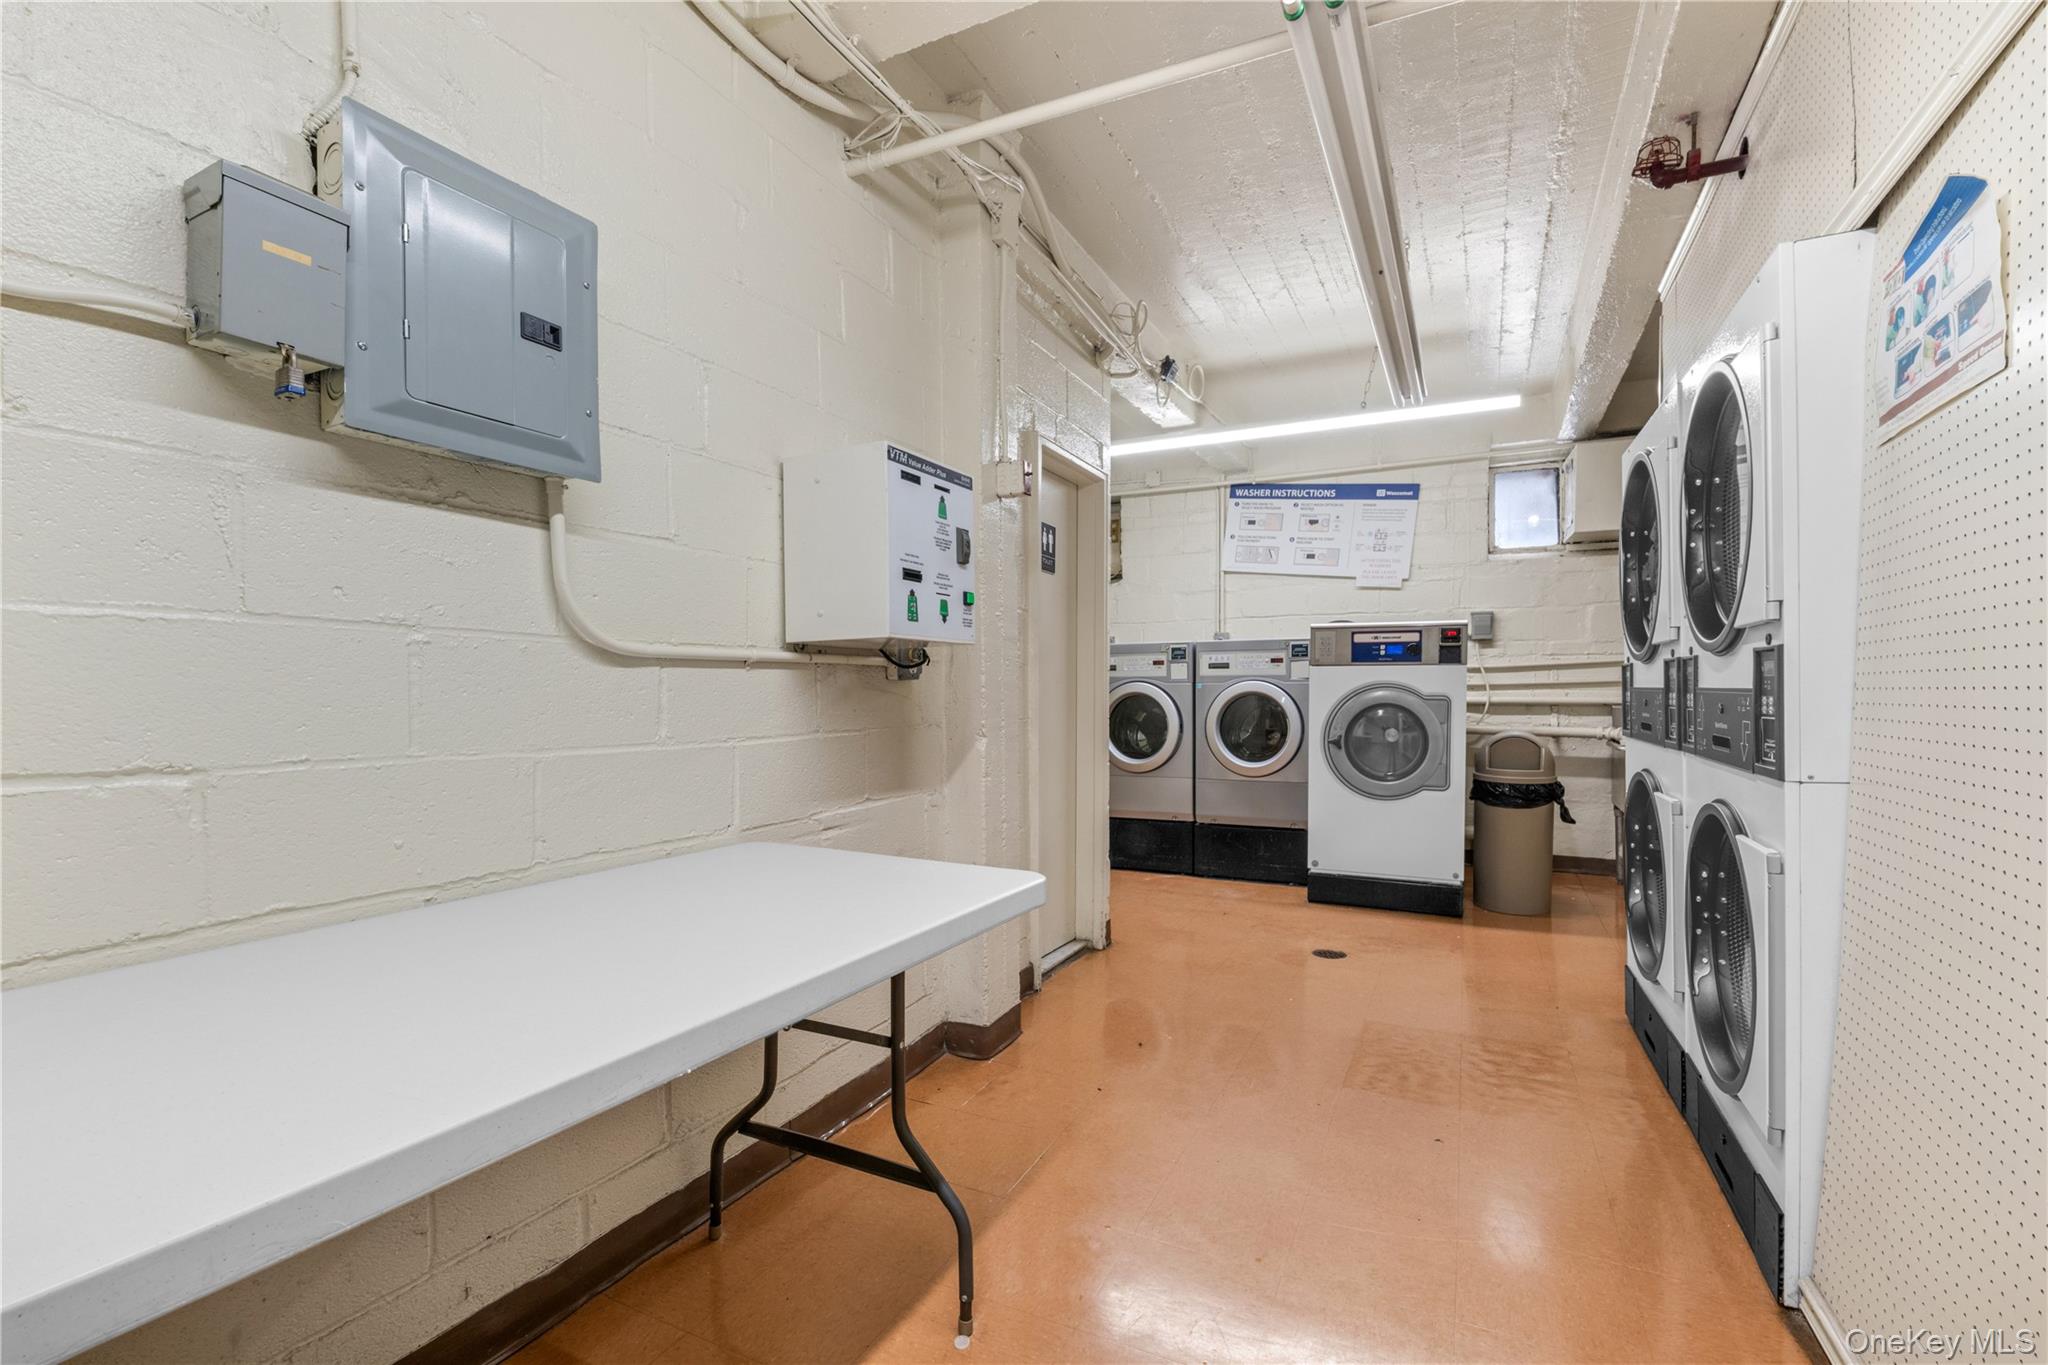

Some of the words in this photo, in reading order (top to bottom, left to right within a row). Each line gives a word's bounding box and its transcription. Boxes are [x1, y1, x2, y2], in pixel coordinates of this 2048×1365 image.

[890, 447, 908, 464] VTM
[908, 459, 921, 468] Value
[922, 464, 936, 474] Adder
[936, 469, 947, 478] Plus
[1235, 488, 1271, 497] WASHER
[1272, 489, 1336, 498] INSTRUCTIONS
